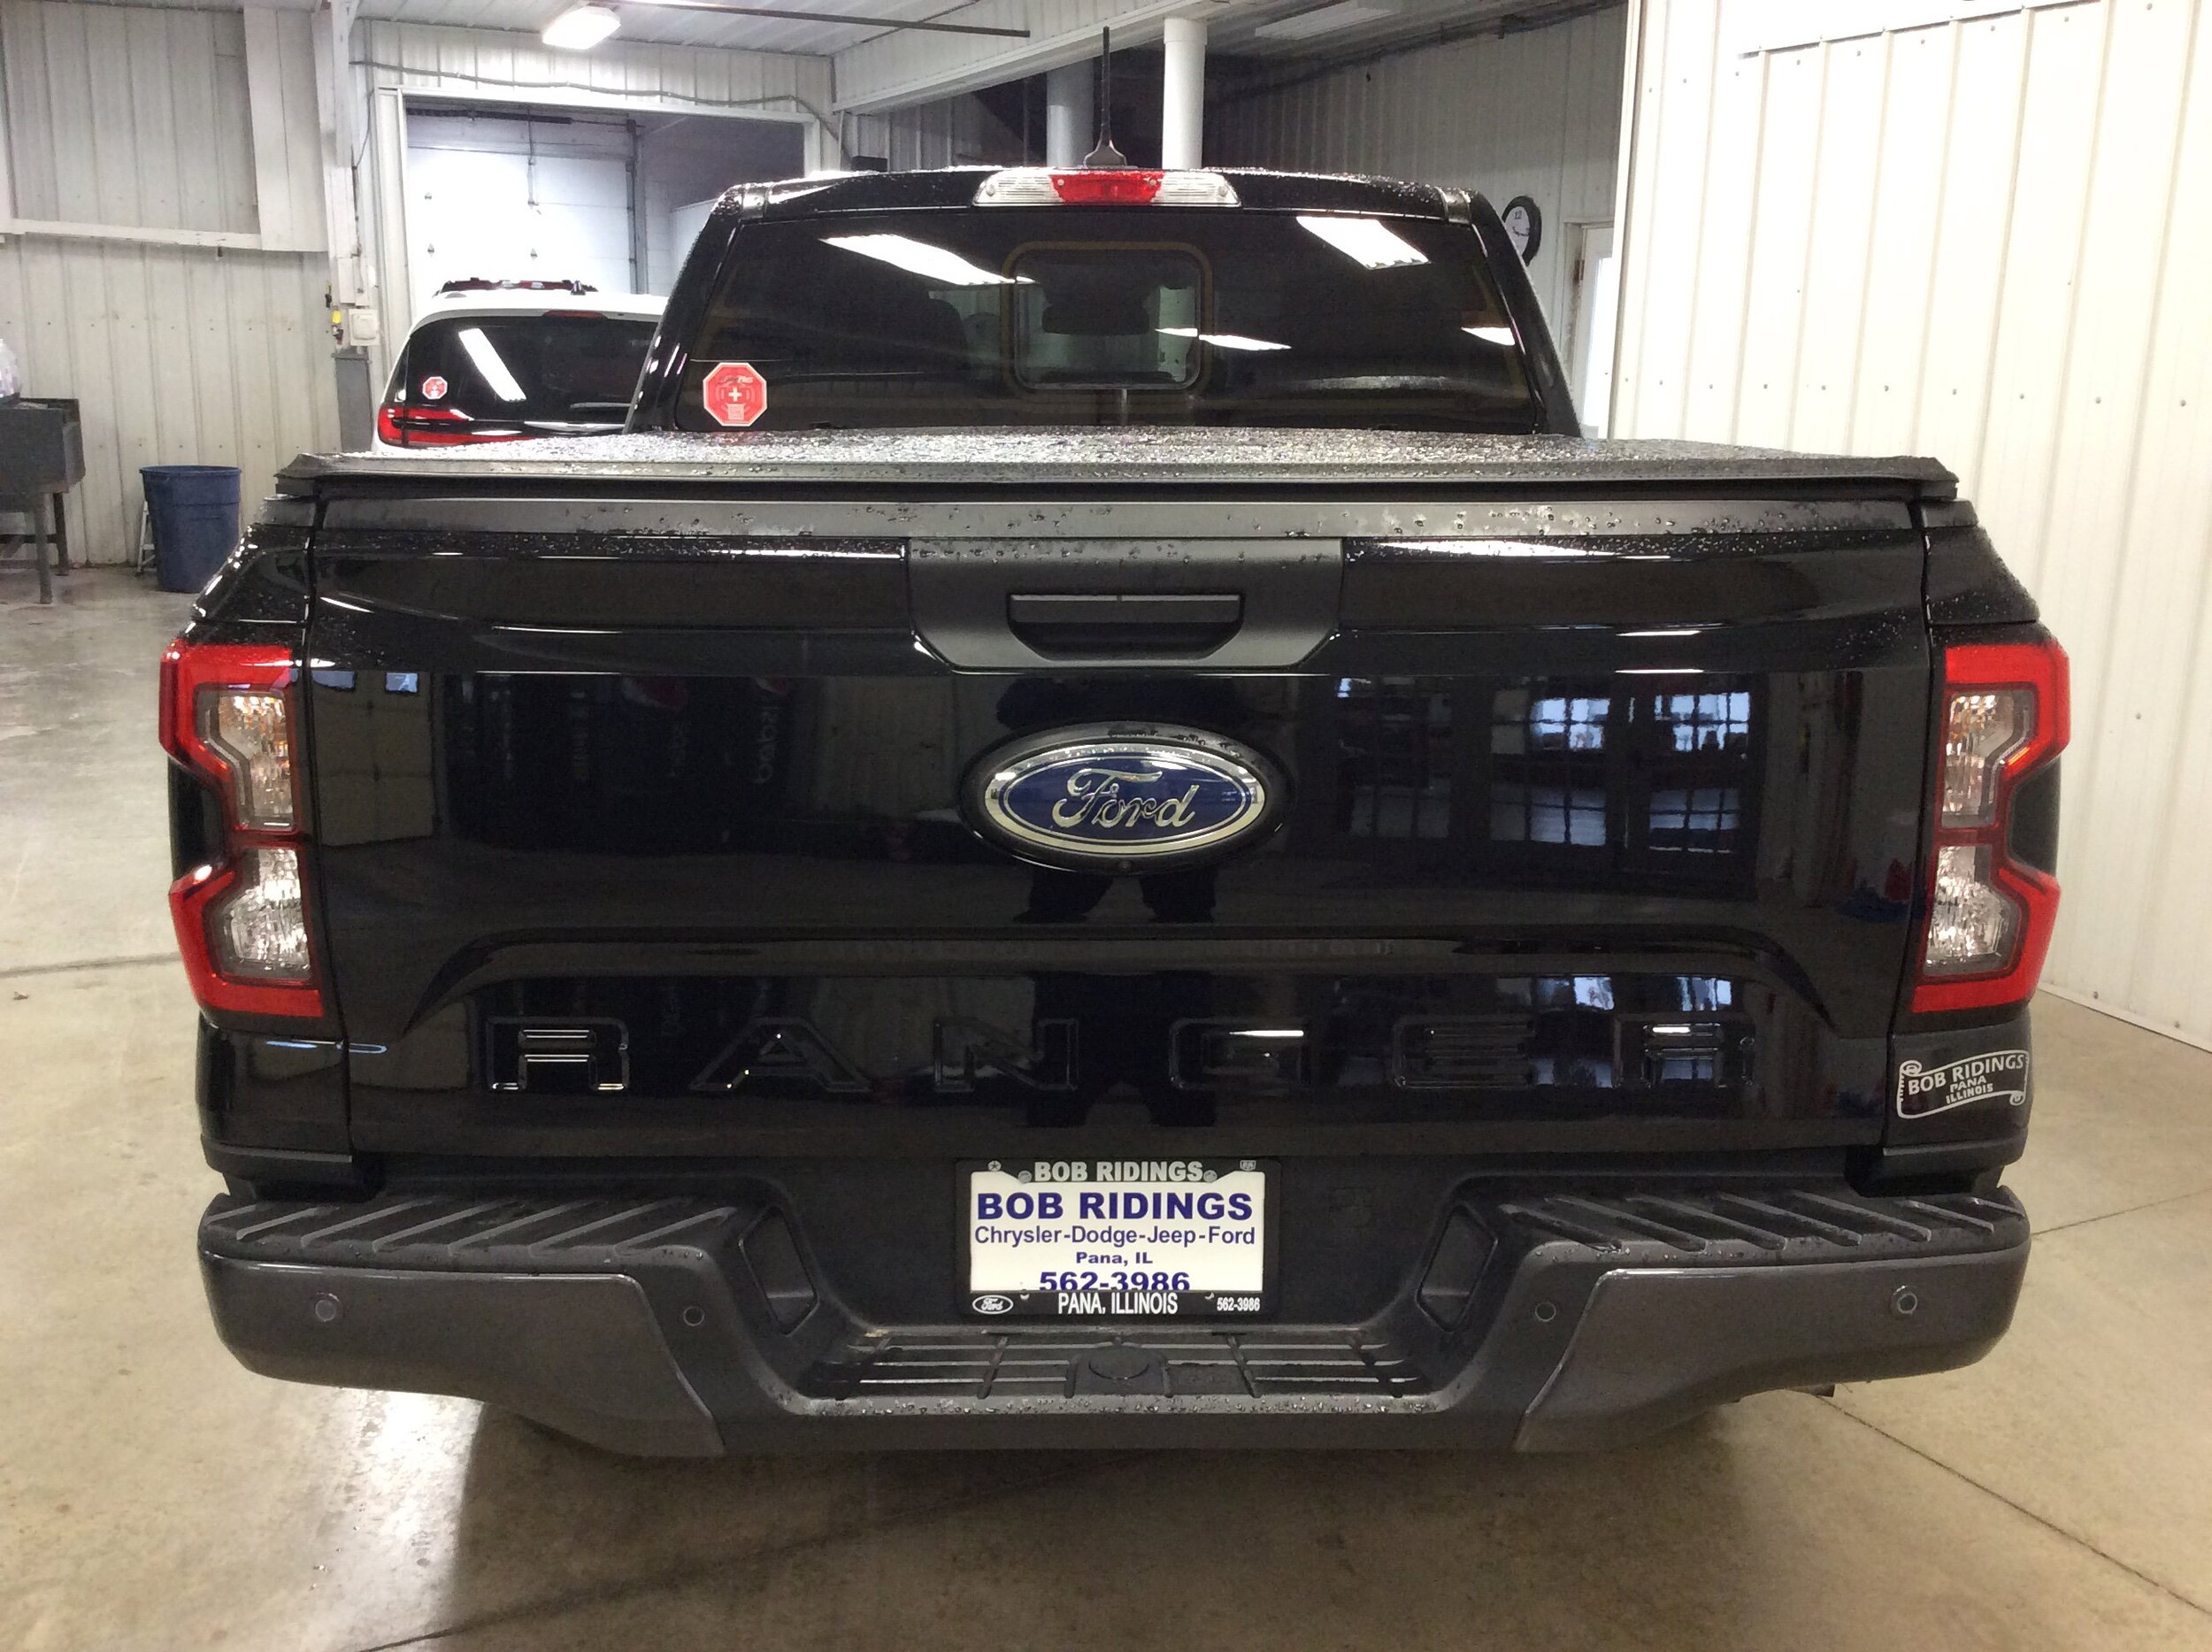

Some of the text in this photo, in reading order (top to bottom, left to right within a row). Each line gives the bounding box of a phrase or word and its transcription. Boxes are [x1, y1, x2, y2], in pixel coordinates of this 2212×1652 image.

[1052, 768, 1200, 828] Ford
[485, 1014, 1755, 1092] RANGER
[1908, 1054, 2024, 1095] BOB RIDINGS
[1949, 1075, 1986, 1093] PANA
[1946, 1083, 1993, 1104] ILLINOIS
[1033, 1161, 1203, 1181] BOB RIDINGS
[977, 1192, 1253, 1220] BOB RIDINGS
[974, 1225, 1256, 1248] Chrysler-Dodge-Jeep-Ford
[1076, 1251, 1153, 1266] Pana, IL
[1039, 1272, 1190, 1291] 562-3986
[981, 1297, 1003, 1310] Ford
[1058, 1292, 1178, 1315] PANA, ILLINOIS
[1217, 1297, 1261, 1311] 562-3986
